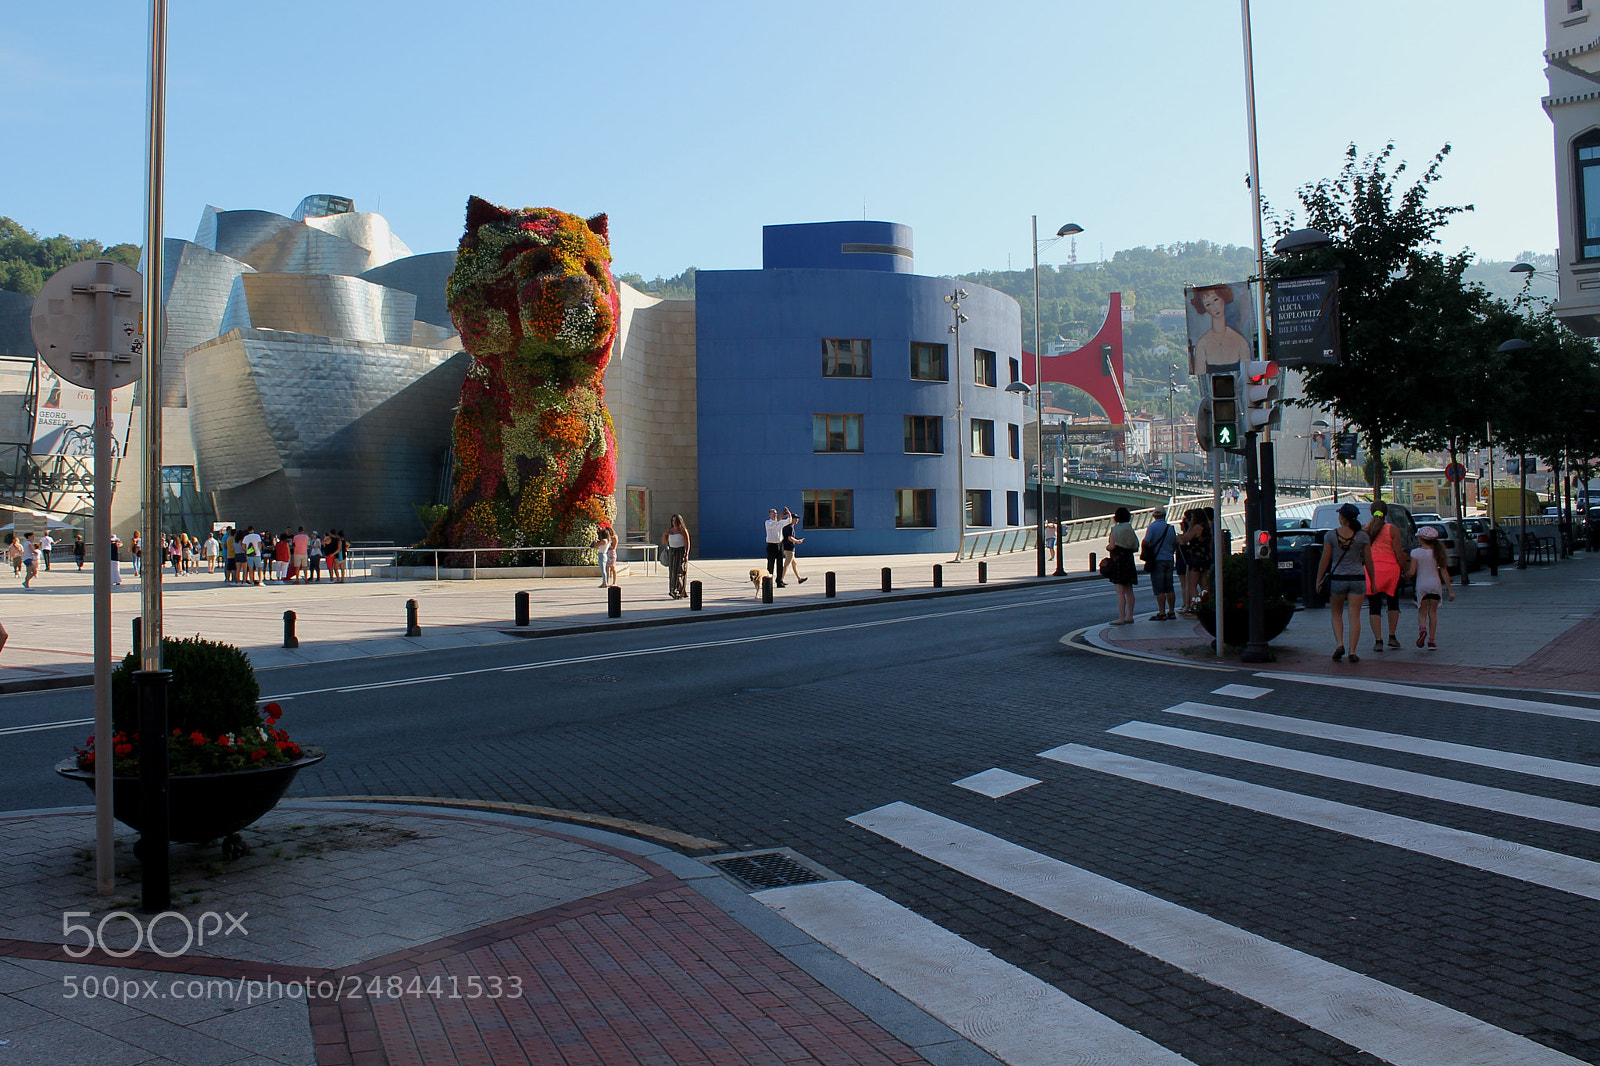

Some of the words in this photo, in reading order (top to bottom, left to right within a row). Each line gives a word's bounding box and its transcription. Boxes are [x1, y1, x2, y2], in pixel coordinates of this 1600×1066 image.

[1279, 303, 1302, 311] ALICIA
[1278, 310, 1321, 320] KOPLOWITZ
[39, 410, 67, 419] GEORG
[38, 418, 74, 427] BASELITZ
